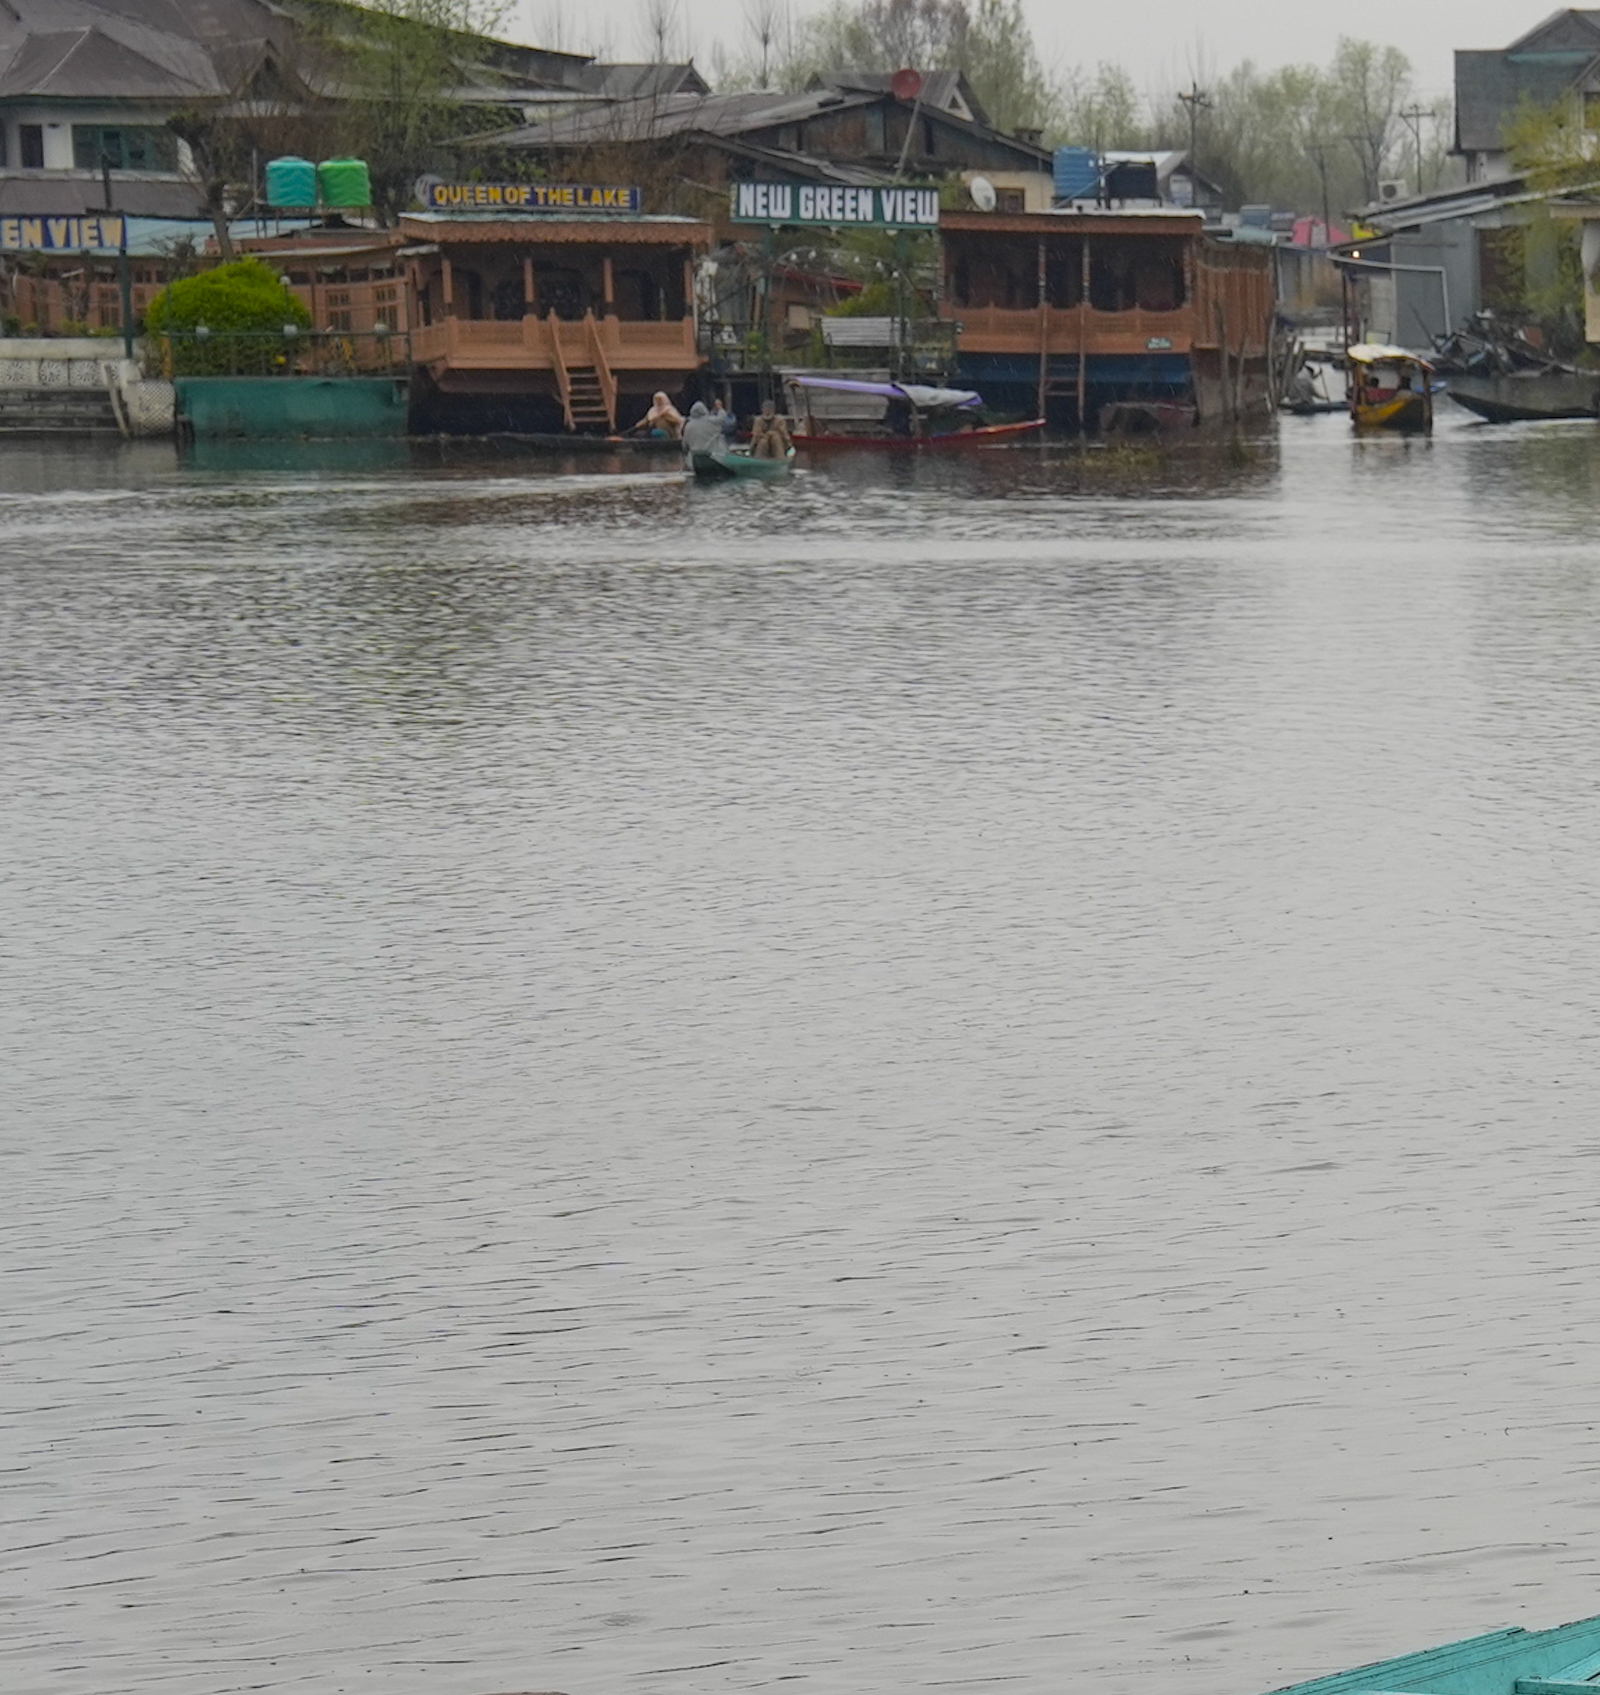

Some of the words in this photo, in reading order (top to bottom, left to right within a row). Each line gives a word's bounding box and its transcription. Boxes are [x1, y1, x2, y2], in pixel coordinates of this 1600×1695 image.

[433, 185, 500, 206] QUEEN
[504, 186, 531, 204] OF
[534, 187, 573, 206] THE
[577, 187, 631, 207] LAKE
[739, 184, 792, 218] NEW
[799, 186, 874, 222] GREEN
[880, 188, 939, 225] VIEW
[46, 218, 123, 248] VIEW
